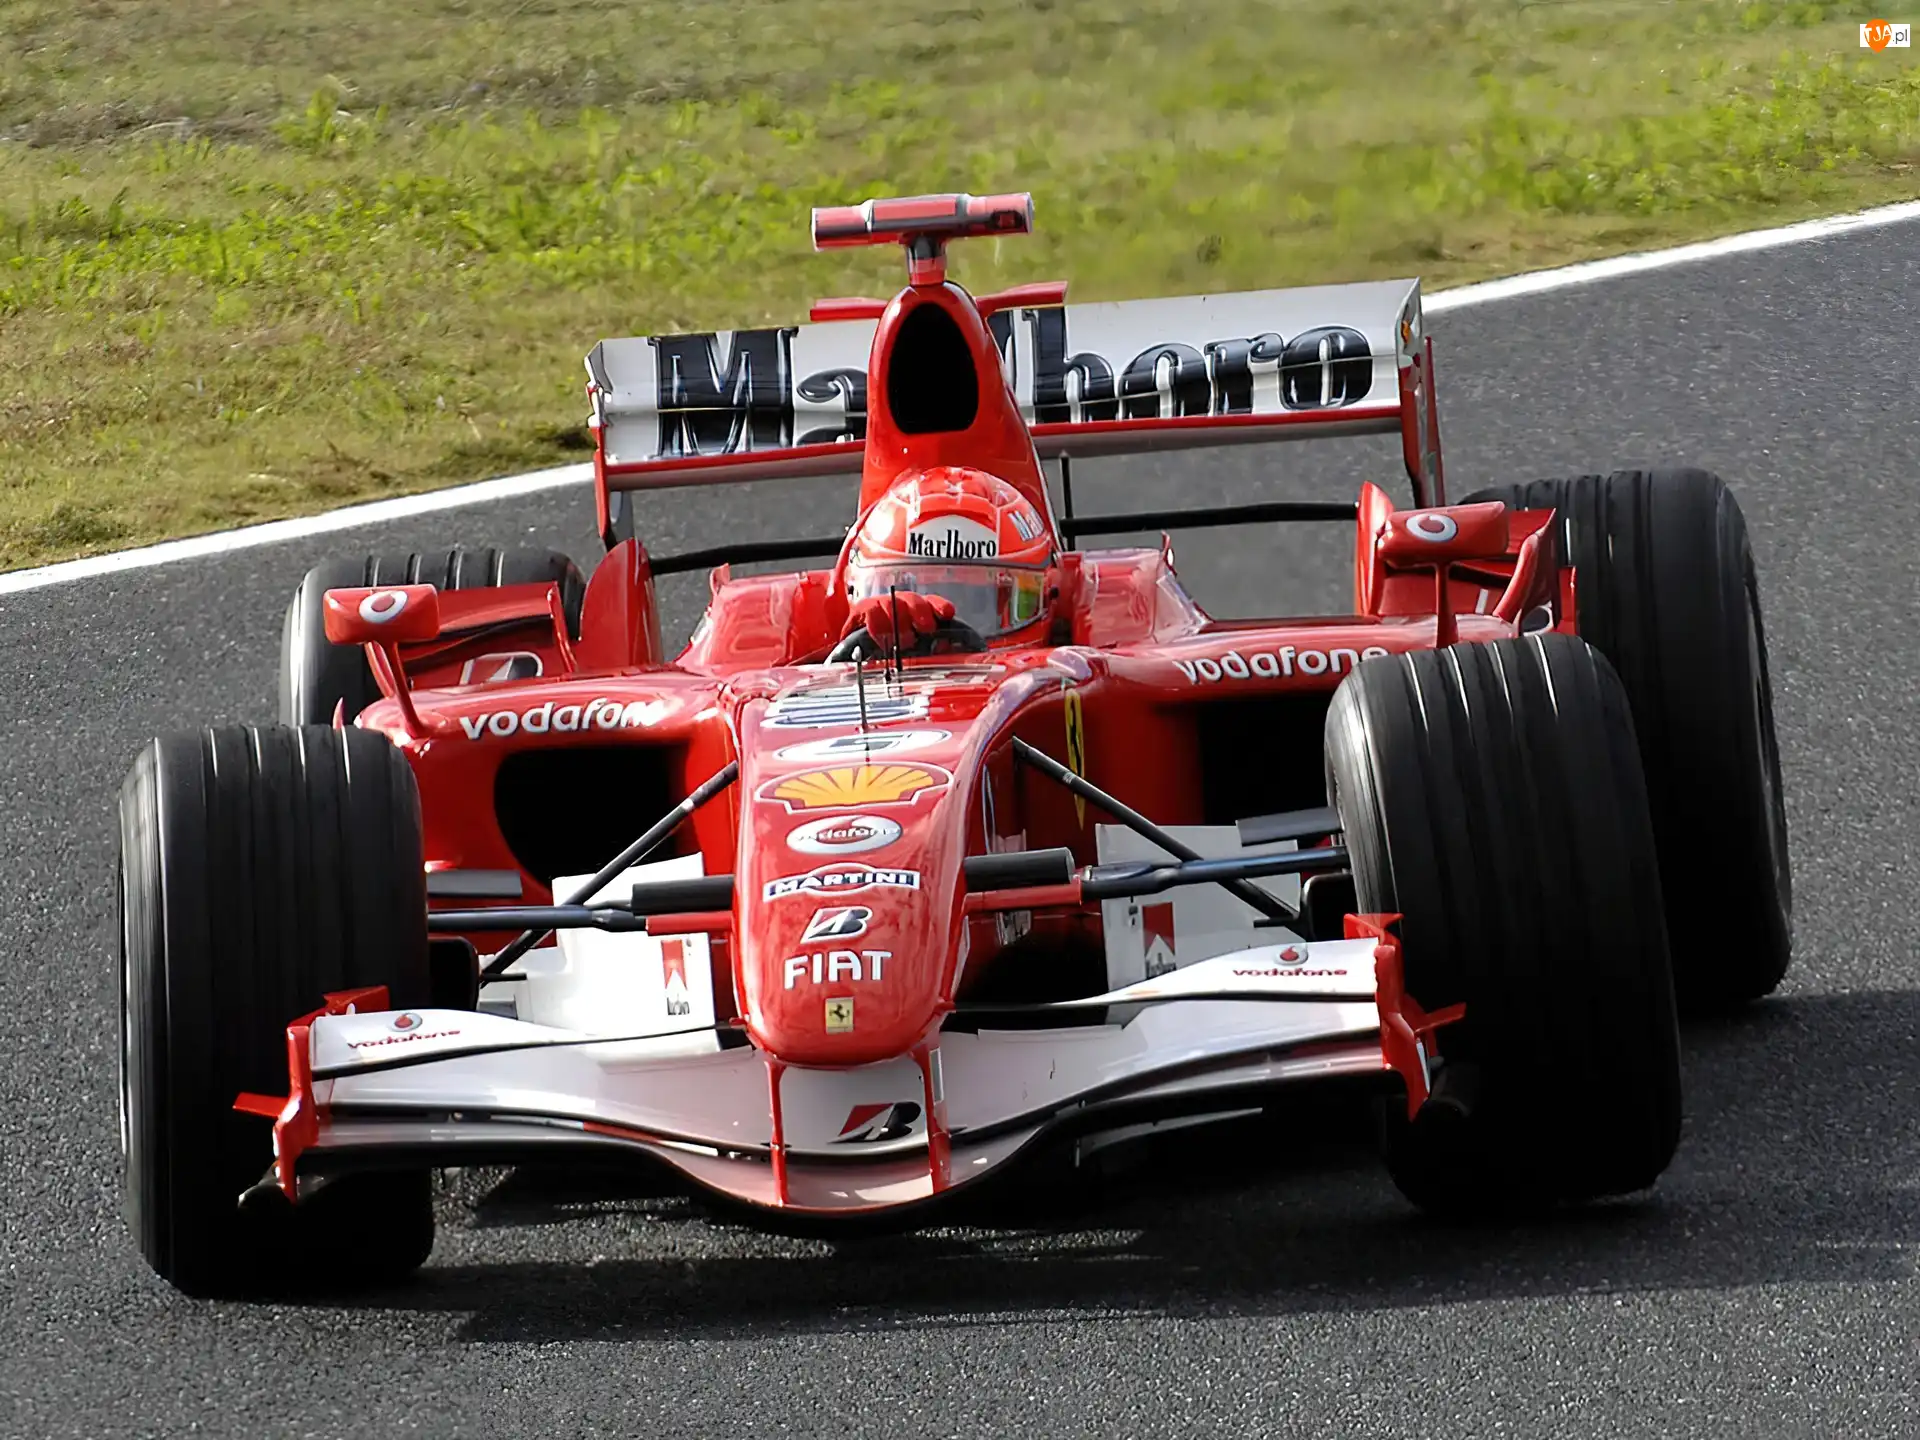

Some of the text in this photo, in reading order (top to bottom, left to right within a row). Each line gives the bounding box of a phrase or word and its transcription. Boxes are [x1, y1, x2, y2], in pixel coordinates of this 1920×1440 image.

[907, 529, 997, 559] Marlboro
[775, 872, 908, 894] MARTINI
[784, 950, 892, 991] FIAT
[1232, 967, 1348, 977] vodafone
